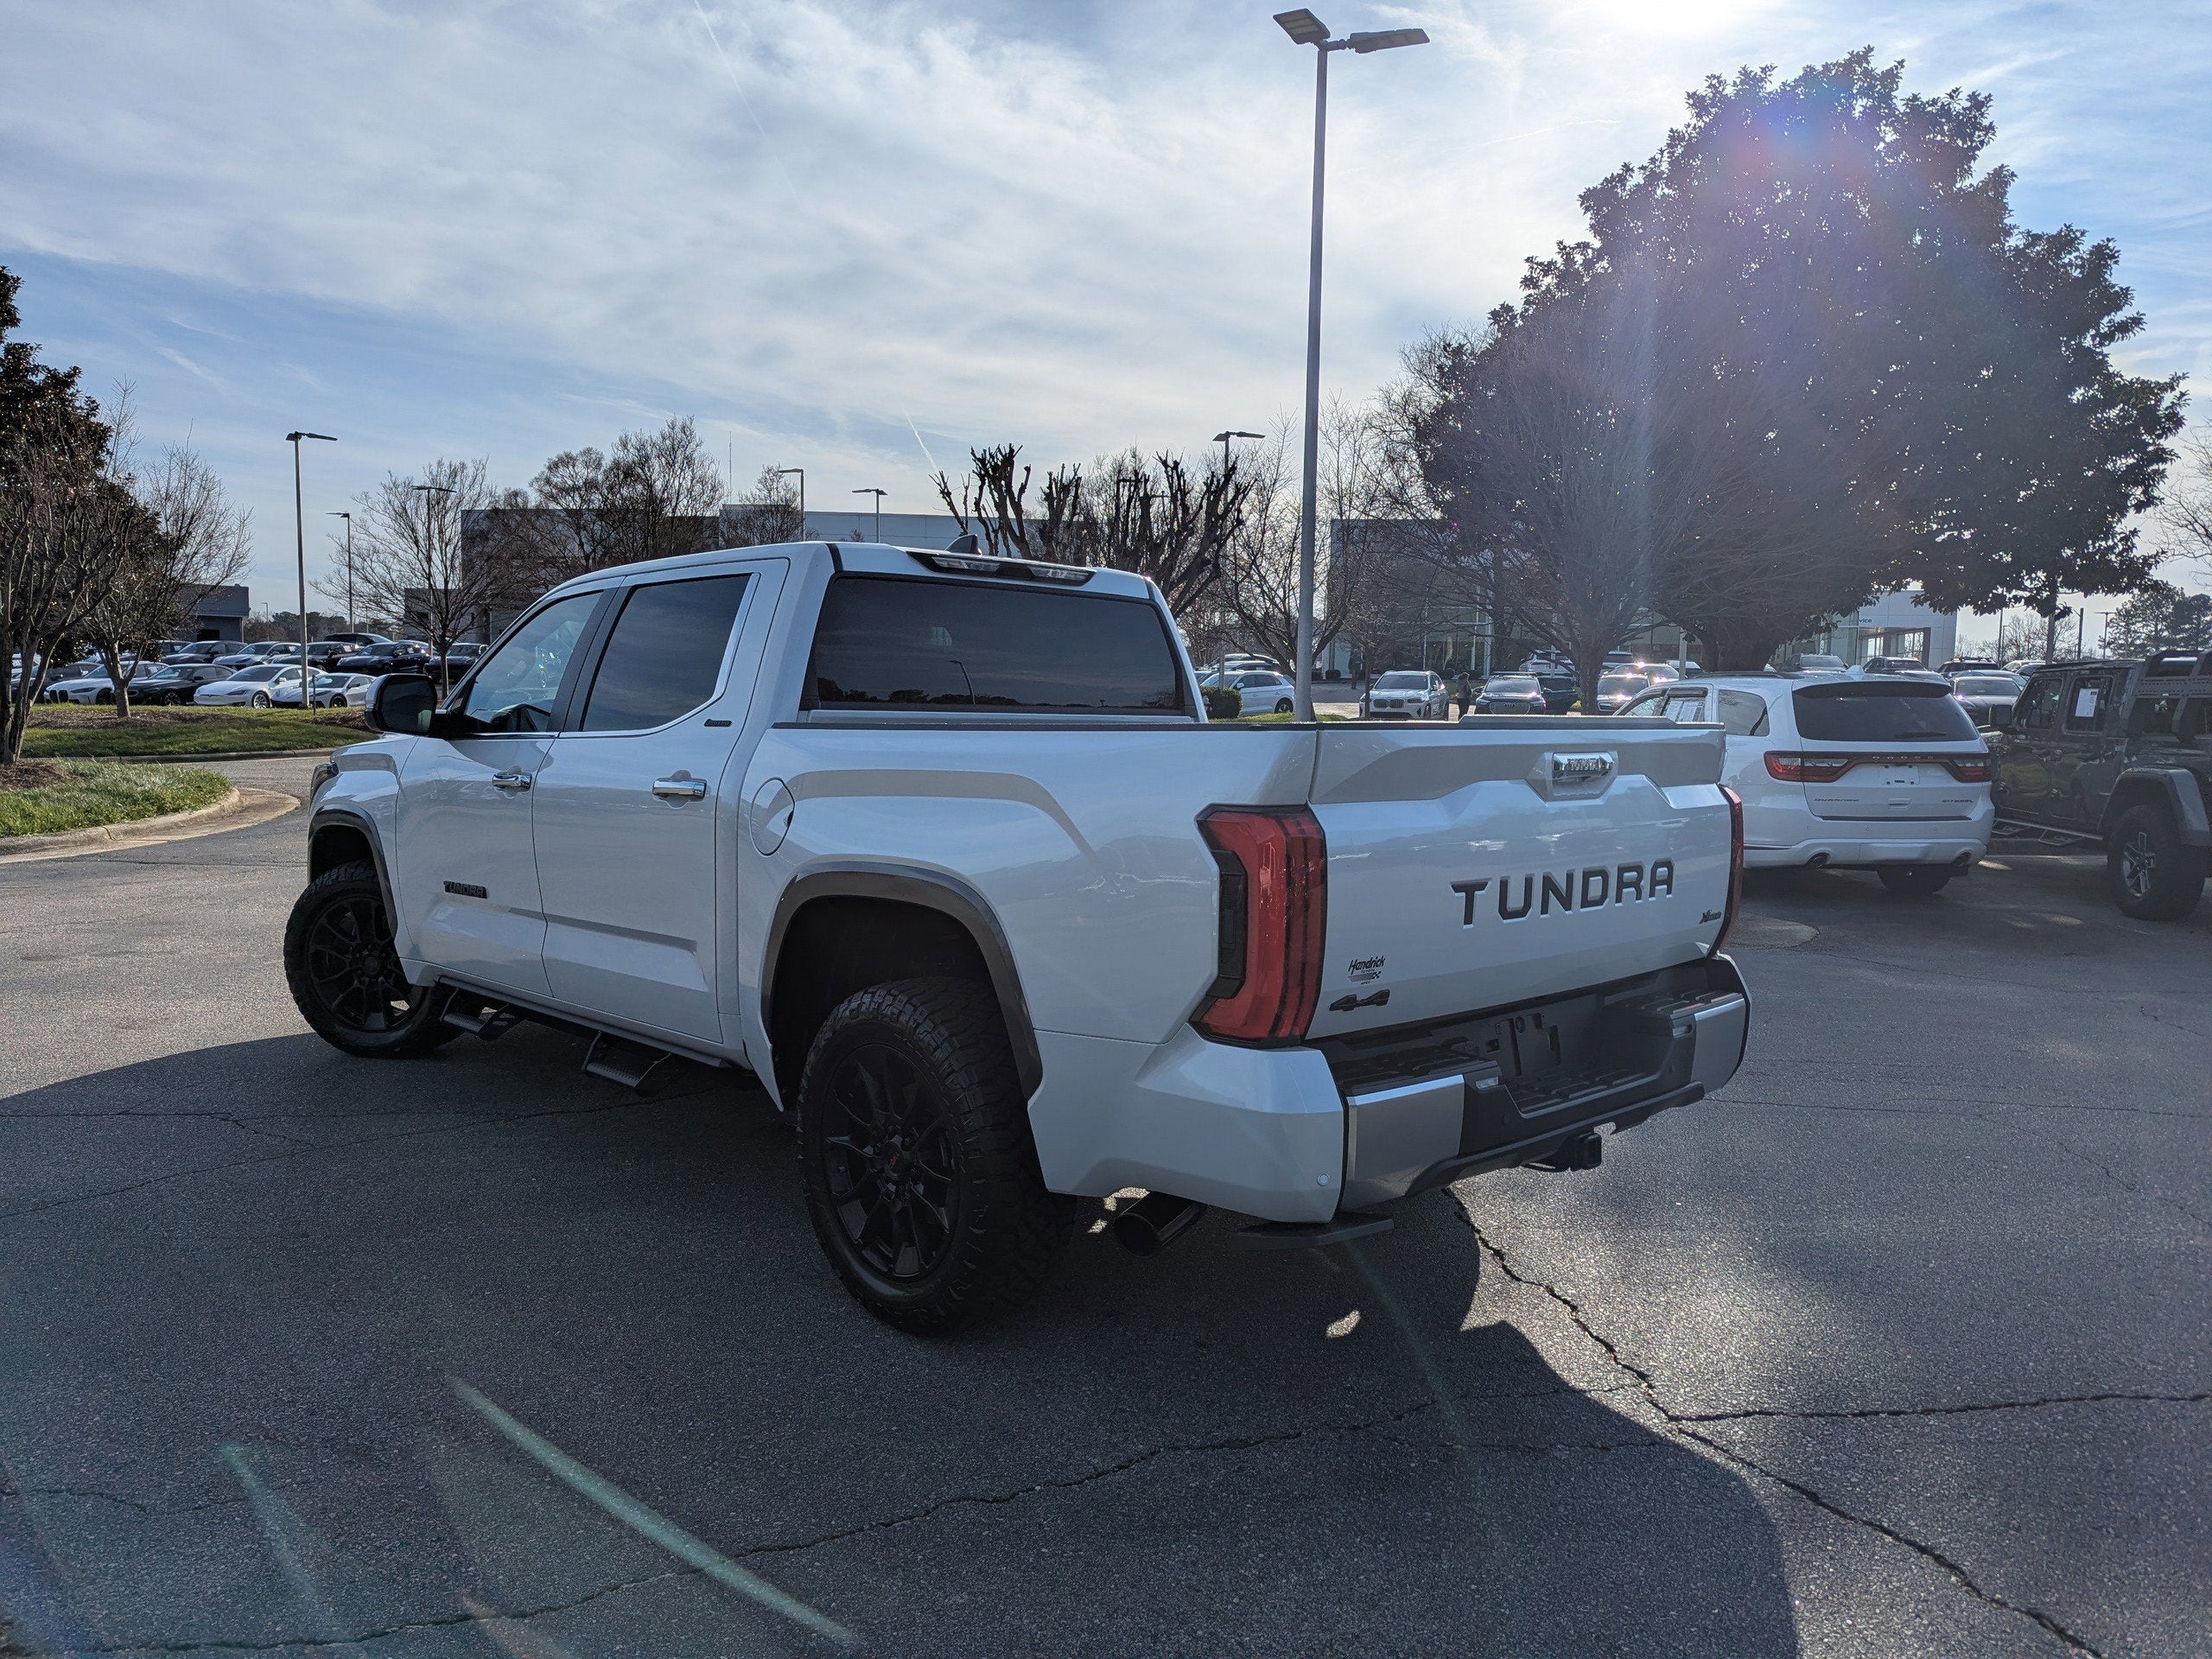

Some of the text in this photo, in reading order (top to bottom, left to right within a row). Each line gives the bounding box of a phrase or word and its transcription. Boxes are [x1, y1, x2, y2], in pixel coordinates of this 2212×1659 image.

[443, 880, 487, 899] TUNDRA
[1451, 858, 1675, 929] TUNDRA
[1348, 955, 1386, 975] Hendrick
